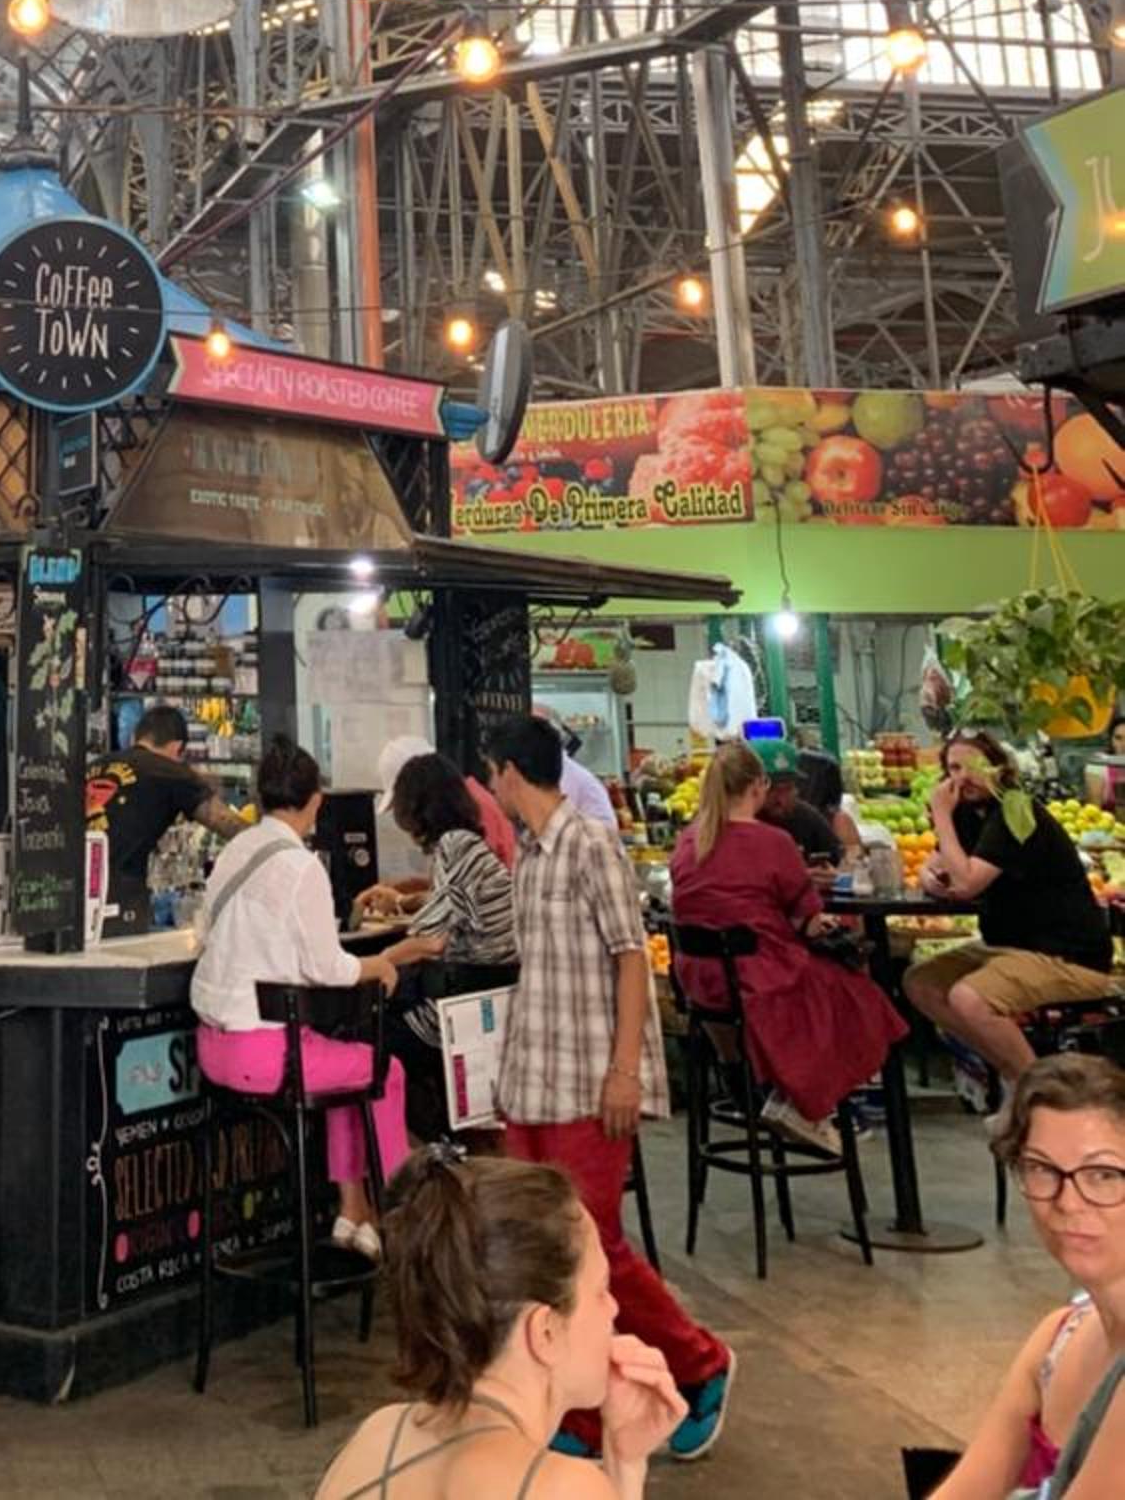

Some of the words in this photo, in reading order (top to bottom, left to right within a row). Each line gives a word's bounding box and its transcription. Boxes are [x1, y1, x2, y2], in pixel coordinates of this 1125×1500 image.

[365, 384, 421, 419] COFFEE
[450, 503, 522, 530] erduras
[528, 486, 563, 524] De
[563, 485, 649, 525] Primera
[653, 479, 744, 521] Calidad
